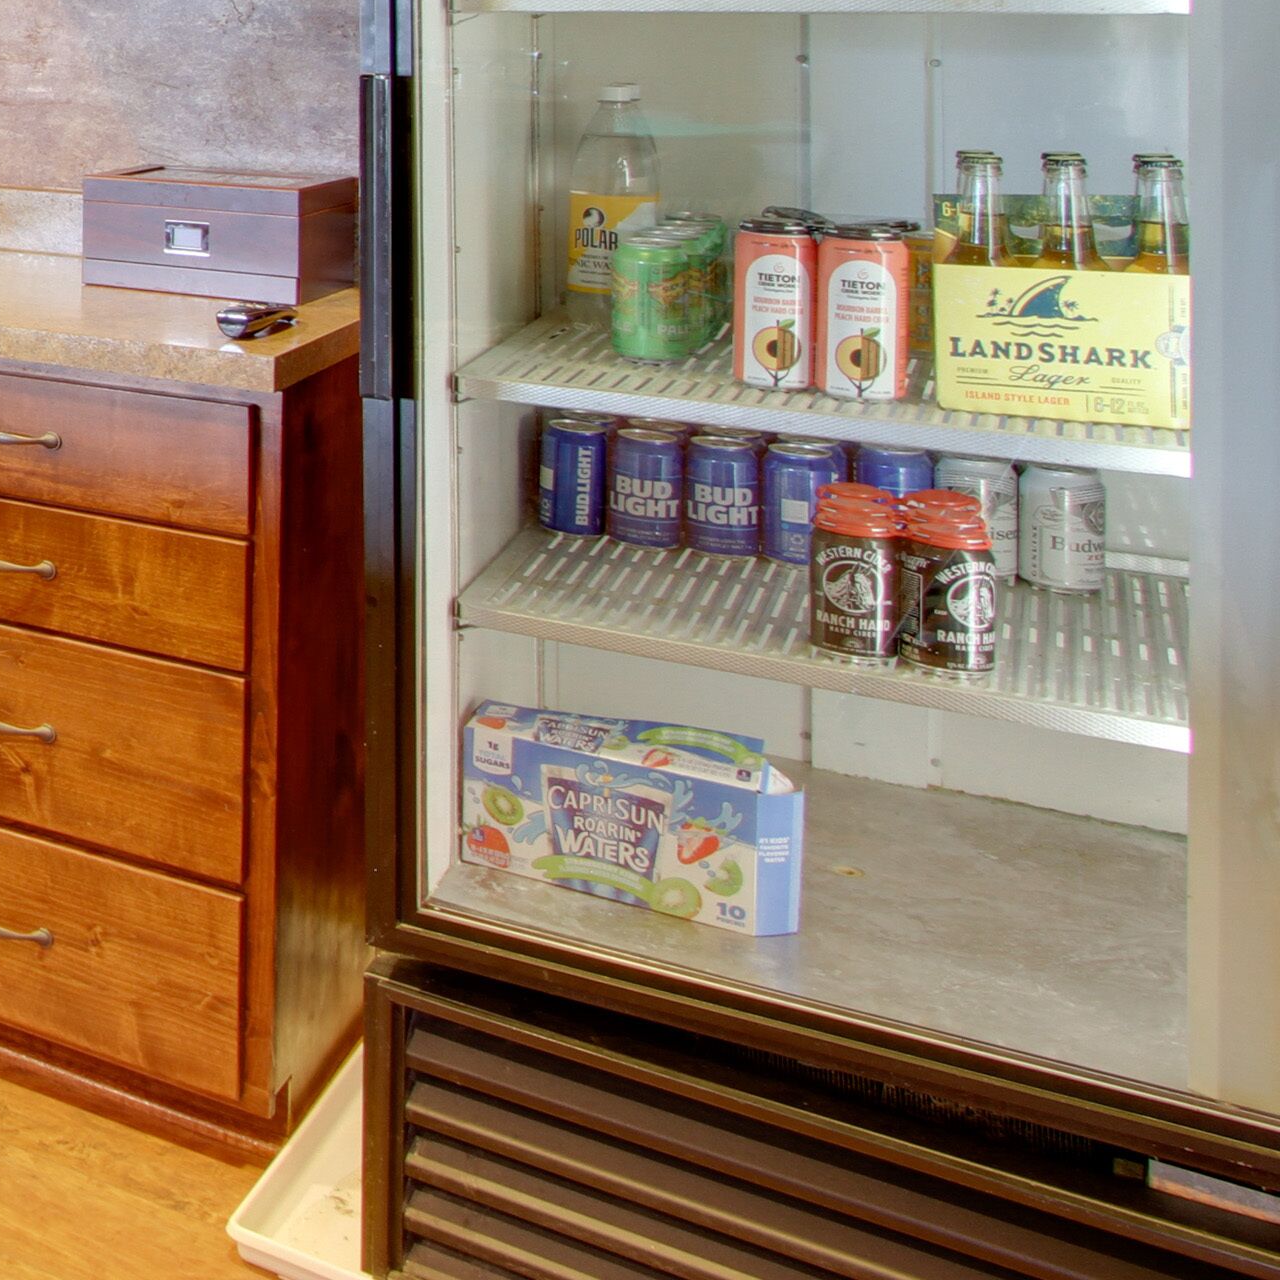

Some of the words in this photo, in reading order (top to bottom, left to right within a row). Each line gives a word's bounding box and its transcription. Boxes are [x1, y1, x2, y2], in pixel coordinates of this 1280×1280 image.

[574, 227, 619, 251] POLAR
[1008, 364, 1091, 389] Lager
[965, 390, 1001, 401] ISLAND
[1004, 393, 1035, 404] STYLE
[1038, 394, 1070, 406] LAGER
[577, 447, 593, 493] LIGHT
[615, 474, 673, 500] BUD
[694, 483, 753, 507] BUD
[575, 493, 590, 526] BUD
[609, 490, 680, 518] LIGHT
[687, 500, 760, 525] LIGHT
[815, 545, 862, 566] WESTERN
[816, 609, 855, 629] RANCH
[937, 629, 980, 645] RANCH
[475, 755, 511, 770] SUGARS
[547, 784, 612, 815] CAPRI
[614, 798, 665, 835] SUN
[573, 815, 642, 843] ROARIN'
[554, 823, 651, 873] WATERS
[716, 901, 746, 921] 10
